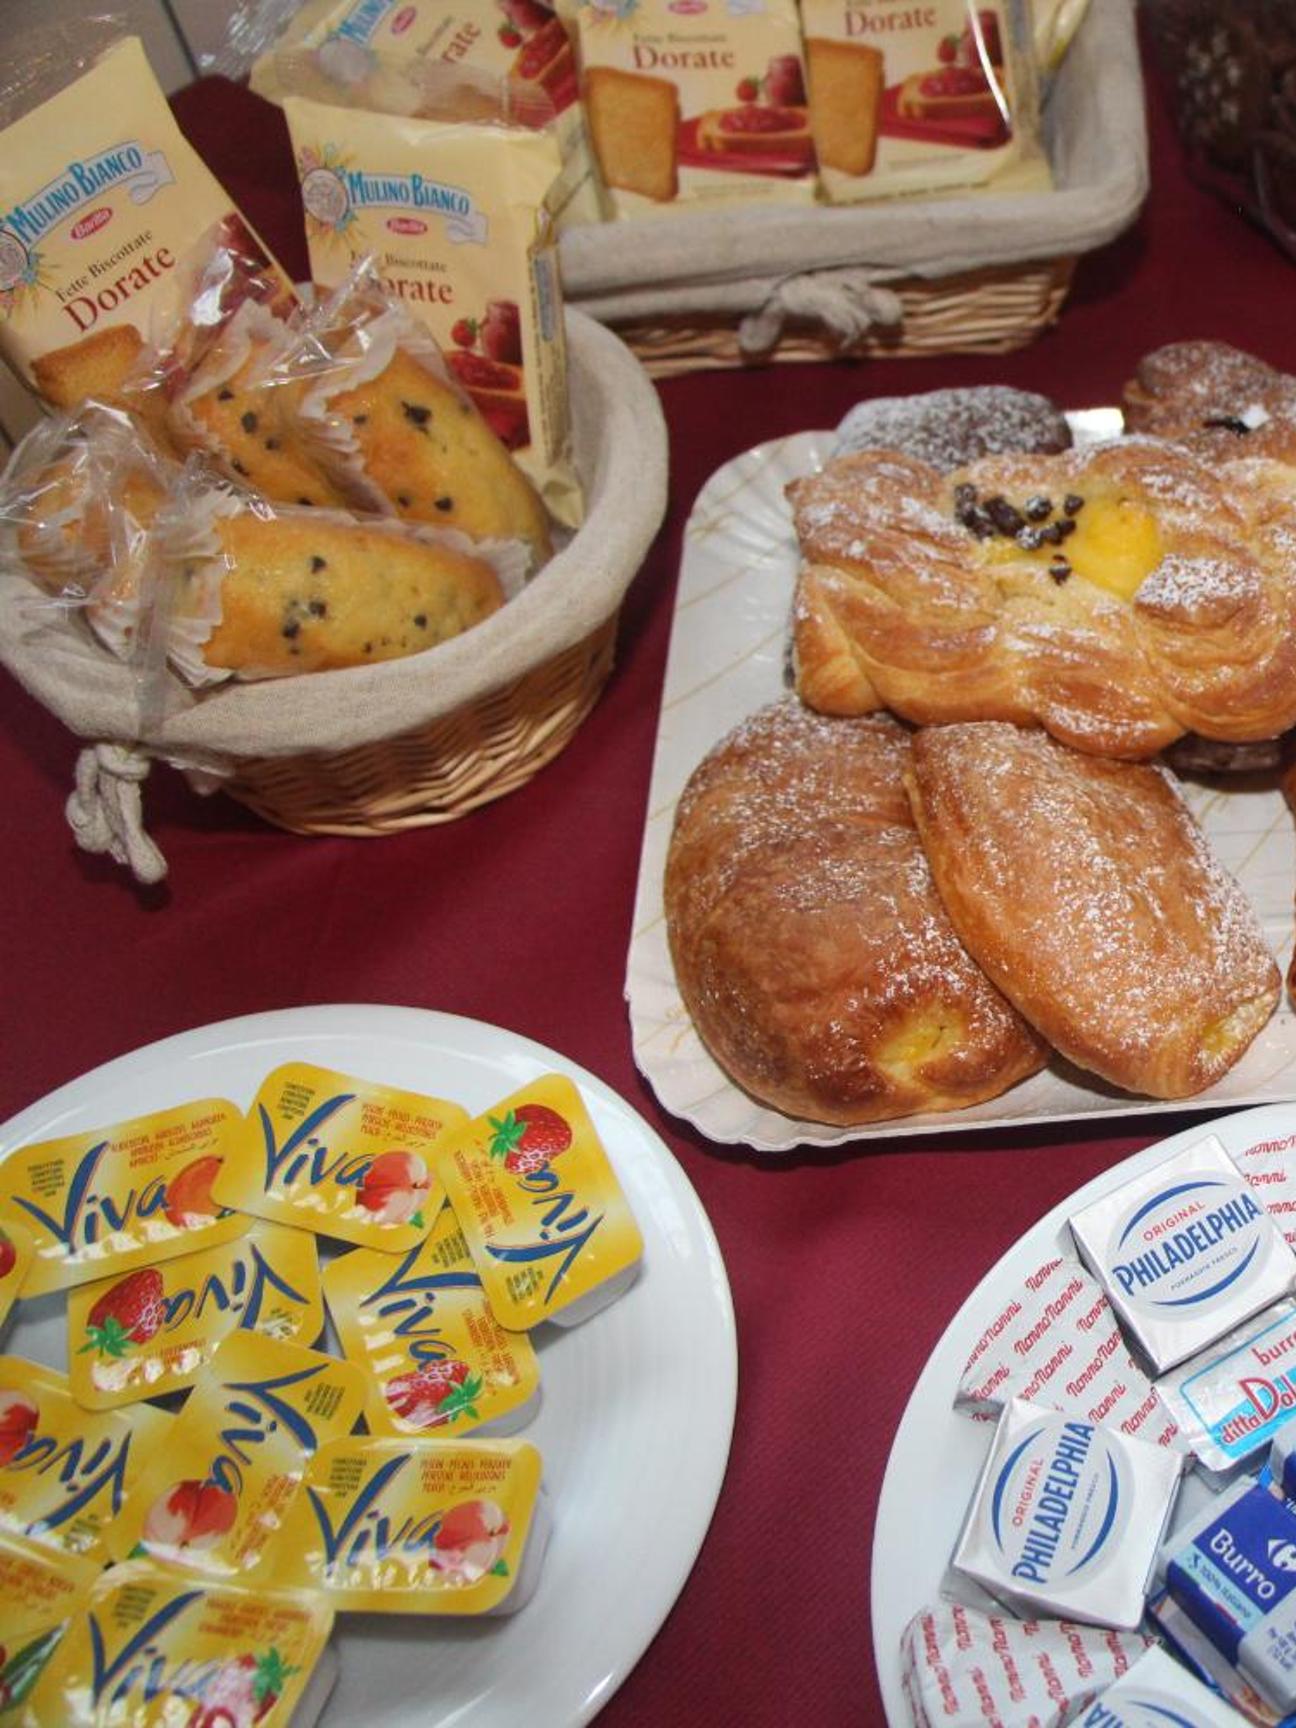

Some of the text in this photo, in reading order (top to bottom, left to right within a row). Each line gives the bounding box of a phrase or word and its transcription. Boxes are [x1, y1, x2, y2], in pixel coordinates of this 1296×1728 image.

[442, 22, 481, 64] rate
[632, 45, 735, 70] Dorate
[843, 6, 937, 36] Dorate
[6, 146, 143, 245] MULINO BIANCO
[347, 170, 471, 216] MULINO BIANCO
[55, 229, 153, 304] Fette Biscottate
[63, 246, 177, 333] Dorate
[378, 275, 454, 305] orate
[258, 1092, 375, 1195] Viva
[10, 1140, 171, 1256] Viva
[484, 1161, 606, 1306] Viva
[1142, 1200, 1207, 1243] ORIGINAL
[161, 1242, 312, 1333] Viva
[1111, 1191, 1265, 1297] PHILADELPHIA
[358, 1243, 483, 1375] Viva
[205, 1362, 330, 1498] Viva
[8, 1429, 133, 1536] Viva
[306, 1450, 445, 1578] Viva
[1011, 1457, 1045, 1528] ORIGINAL
[1011, 1420, 1096, 1585] PHILADELPHIA
[1209, 1528, 1277, 1600] Burro
